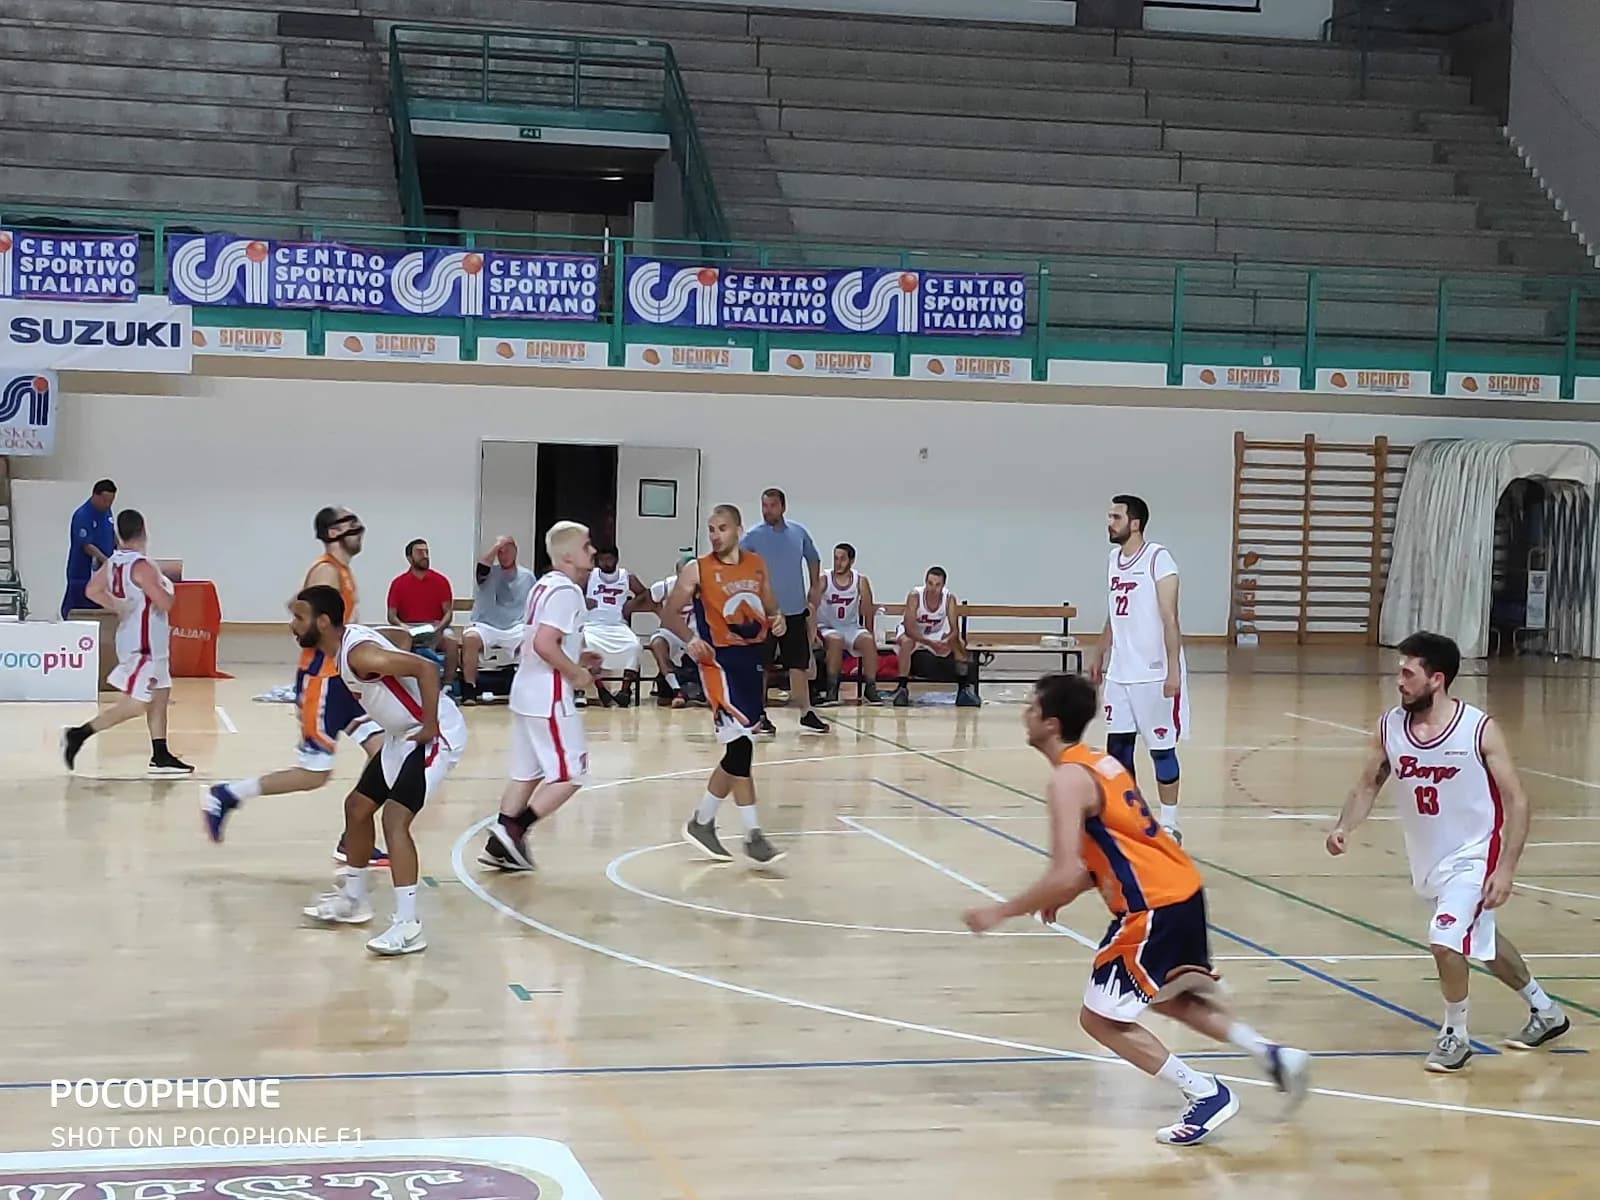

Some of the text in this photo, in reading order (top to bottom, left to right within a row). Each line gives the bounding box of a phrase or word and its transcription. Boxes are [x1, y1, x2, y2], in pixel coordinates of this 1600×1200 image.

[20, 239, 136, 257] CENTRO
[20, 257, 136, 276] SPORTIVO
[275, 247, 385, 271] CENTRO
[275, 266, 385, 288] SPORTIVO
[490, 260, 596, 279] CENTRO
[20, 275, 136, 294] ITALIANO
[490, 278, 596, 296] SPORTIVO
[723, 275, 827, 291] CENTRO
[924, 278, 1023, 296] CENTRO
[275, 284, 385, 305] ITALIANO
[723, 290, 827, 308] SPORTIVO
[490, 295, 596, 313] ITALIANO
[924, 295, 1023, 313] SPORTIVO
[723, 306, 827, 324] ITALIANO
[924, 312, 1023, 330] ITALIANO
[9, 317, 181, 348] SUZUKI
[0, 427, 38, 438] SKET
[1115, 596, 1128, 616] 22
[1414, 786, 1439, 815] 13
